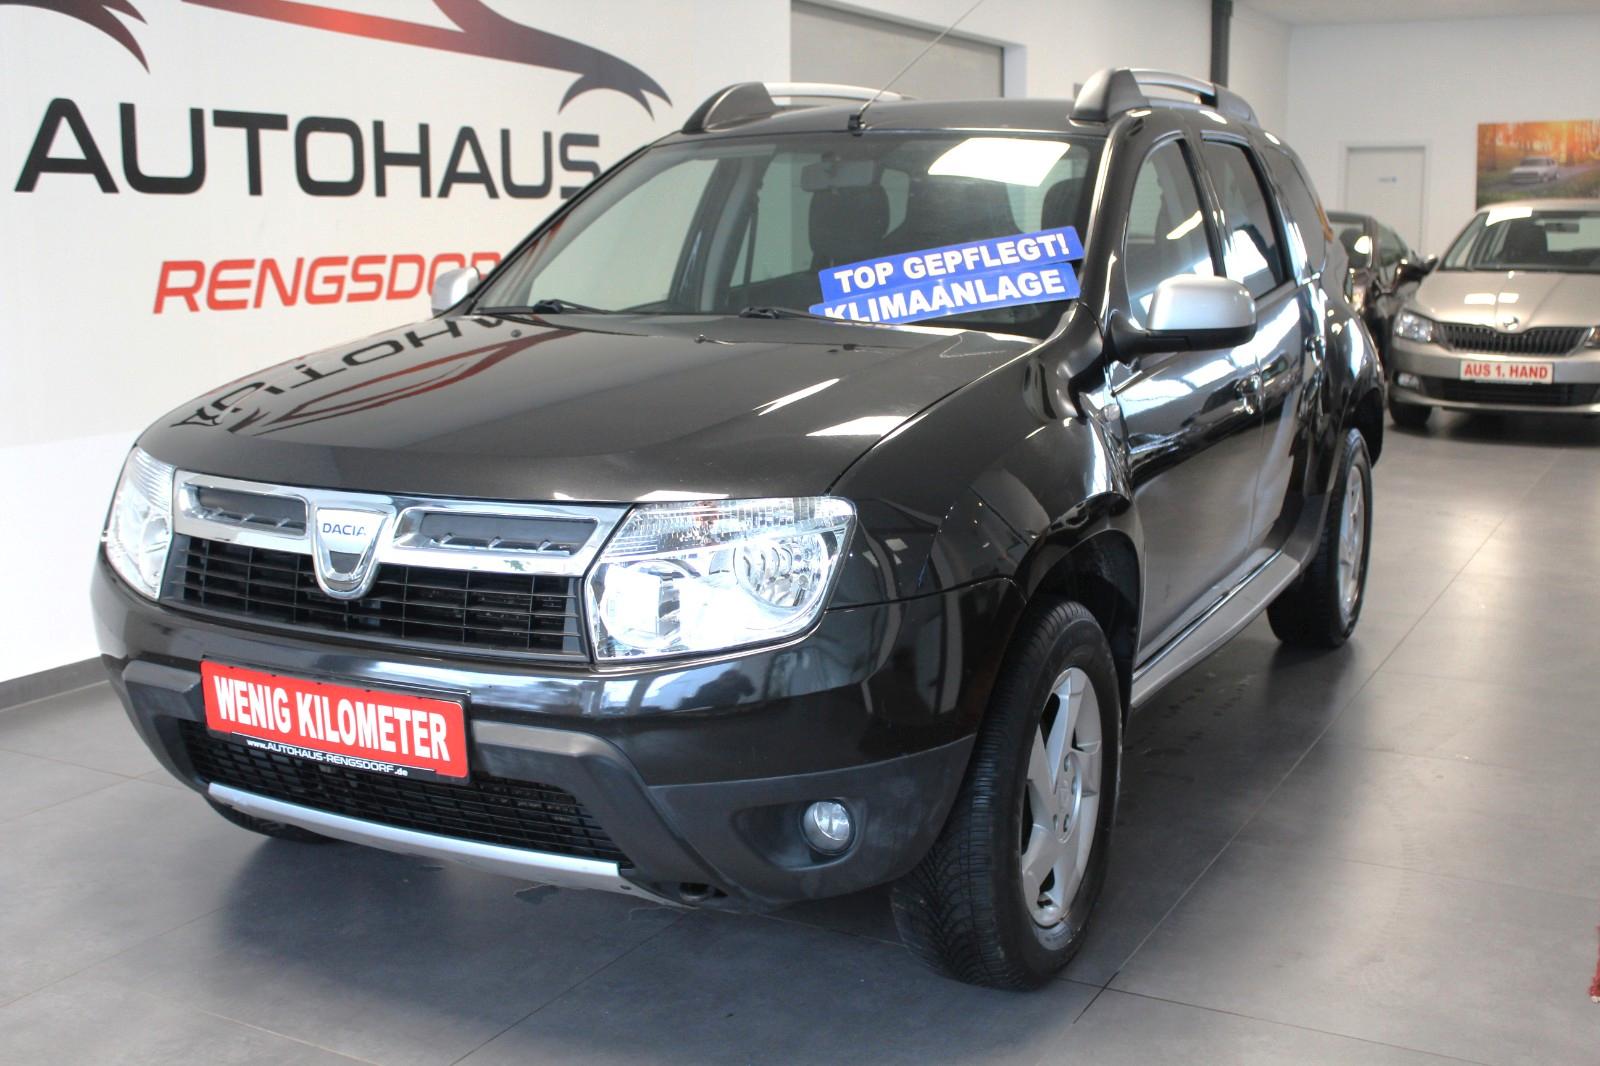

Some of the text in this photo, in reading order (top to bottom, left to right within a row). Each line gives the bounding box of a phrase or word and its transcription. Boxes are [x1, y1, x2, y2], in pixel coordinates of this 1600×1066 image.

[14, 97, 601, 200] AUTOHAUS
[834, 233, 1070, 293] TOP GEPFLEGT!
[824, 269, 1065, 322] KLIMAANLAGE
[1464, 363, 1548, 379] AUS 1. HAND
[322, 522, 367, 536] DACIA
[213, 675, 450, 762] WENIG KILOMETER
